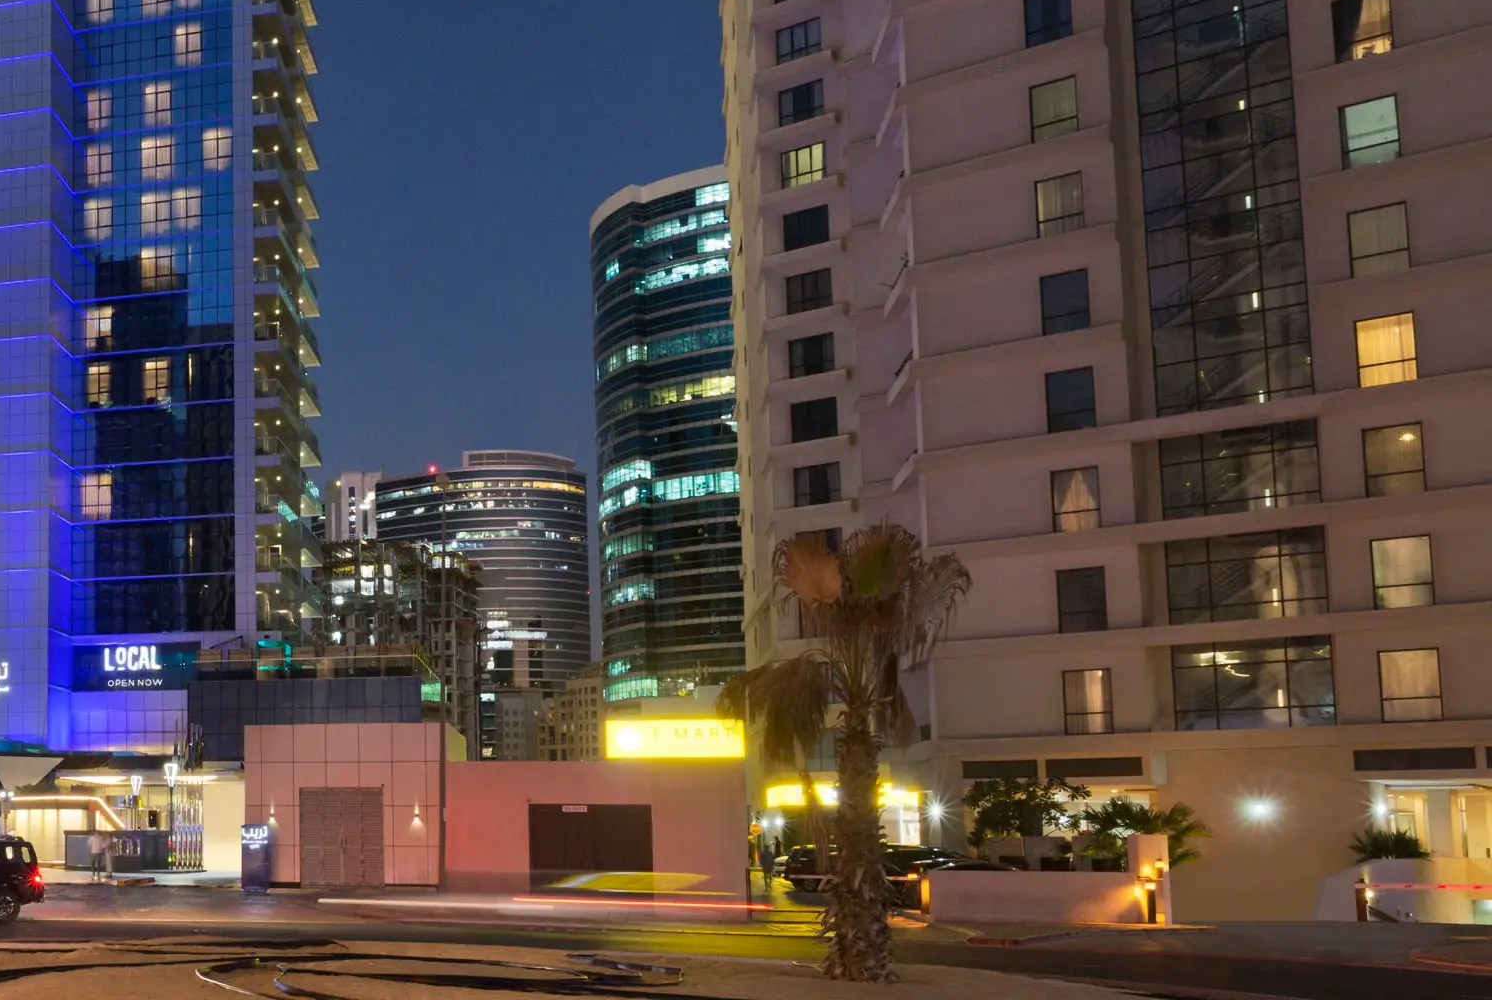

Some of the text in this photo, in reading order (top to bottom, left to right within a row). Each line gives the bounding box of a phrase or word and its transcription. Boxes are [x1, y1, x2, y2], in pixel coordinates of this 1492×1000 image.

[107, 678, 163, 687] OPEN NOW
[241, 826, 268, 839] تريب
